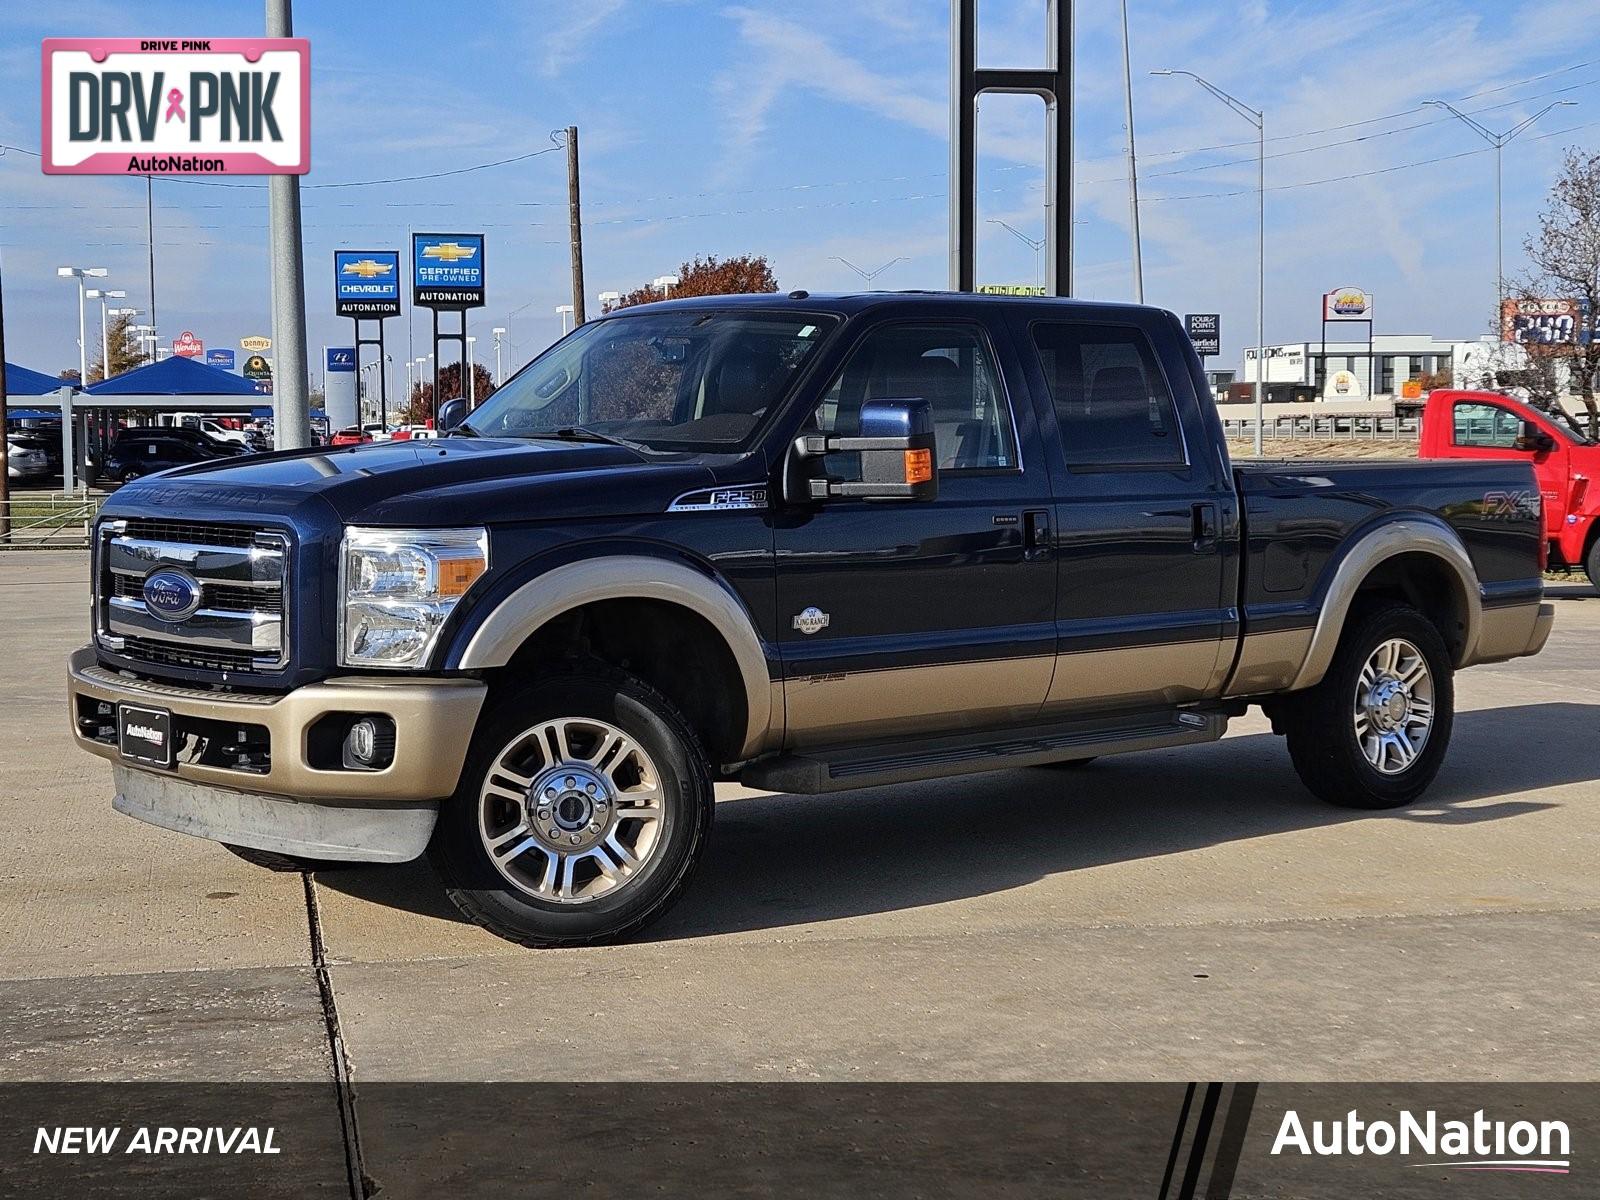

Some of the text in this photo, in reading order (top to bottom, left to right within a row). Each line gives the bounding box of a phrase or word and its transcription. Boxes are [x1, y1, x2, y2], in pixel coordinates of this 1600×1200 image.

[419, 267, 480, 275] CERTIFIED
[341, 285, 395, 293] CHEVROLET
[419, 292, 480, 301] AUTONATION
[341, 303, 397, 312] AUTONATION
[174, 340, 201, 354] Wendy's
[243, 340, 269, 349] Denny's
[151, 579, 181, 605] Ford
[795, 615, 828, 627] KING RANCH
[126, 723, 163, 742] AutoNation
